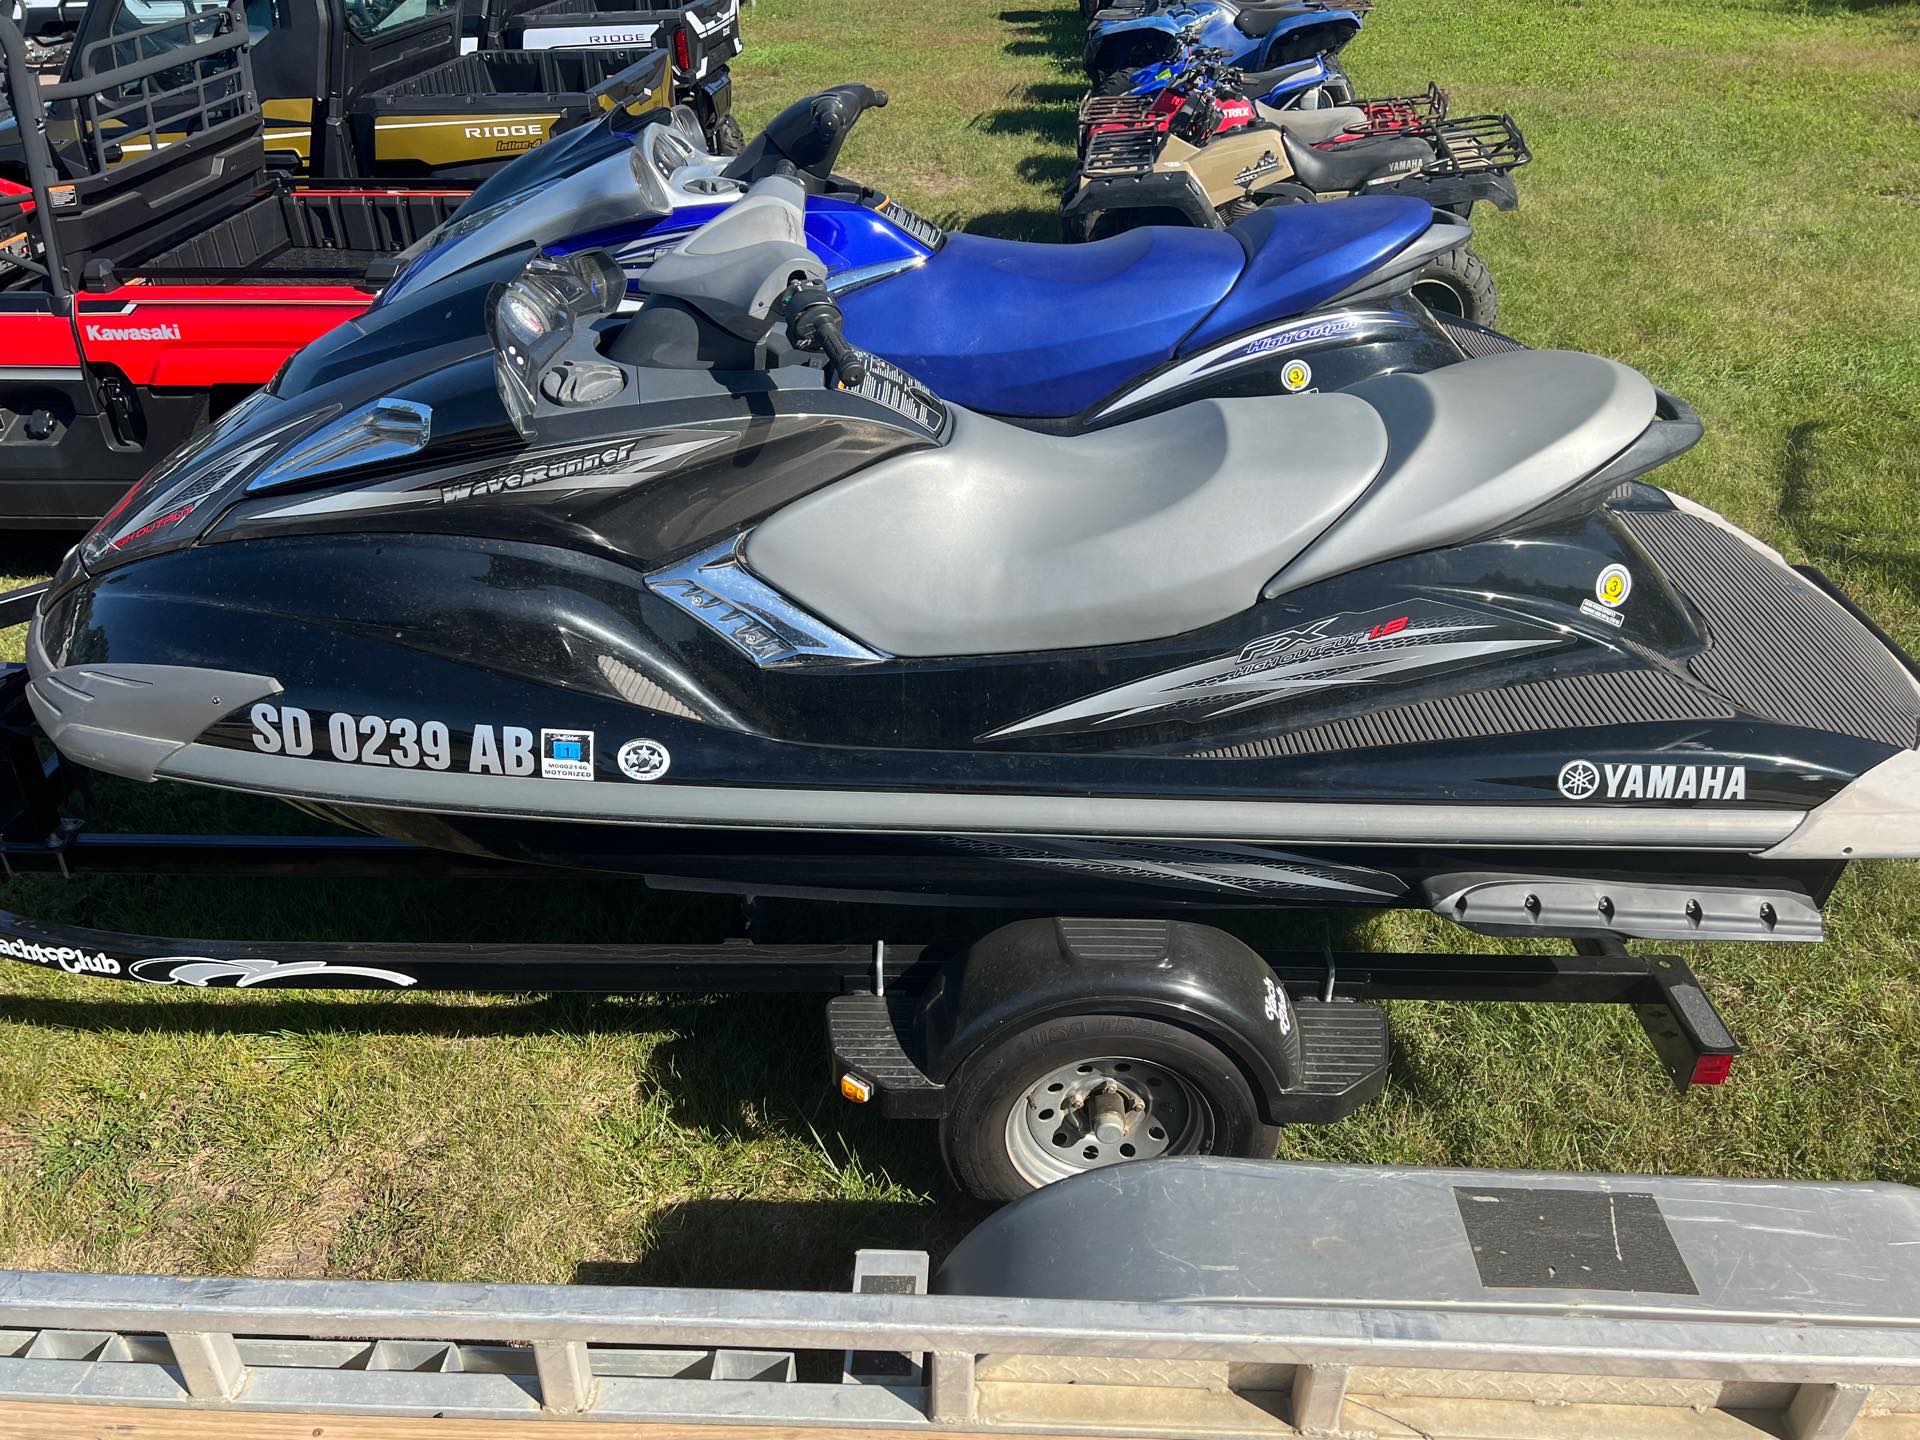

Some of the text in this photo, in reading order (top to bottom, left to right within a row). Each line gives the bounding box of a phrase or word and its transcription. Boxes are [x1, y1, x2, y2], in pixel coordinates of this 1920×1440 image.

[589, 33, 645, 43] RIDGE
[1223, 107, 1249, 119] TRAX
[464, 124, 543, 139] RIDGE
[1389, 158, 1424, 173] YAMAHA
[85, 324, 182, 341] Kawasaki
[1248, 320, 1357, 352] High Output
[441, 442, 638, 503] WaveRunner
[1234, 616, 1409, 678] HIGH OUTPUT 1.8
[1236, 616, 1340, 664] FX
[250, 703, 535, 777] SD 0239 AB
[544, 769, 592, 777] MOTORIZED
[1604, 764, 1745, 800] YAMAHA
